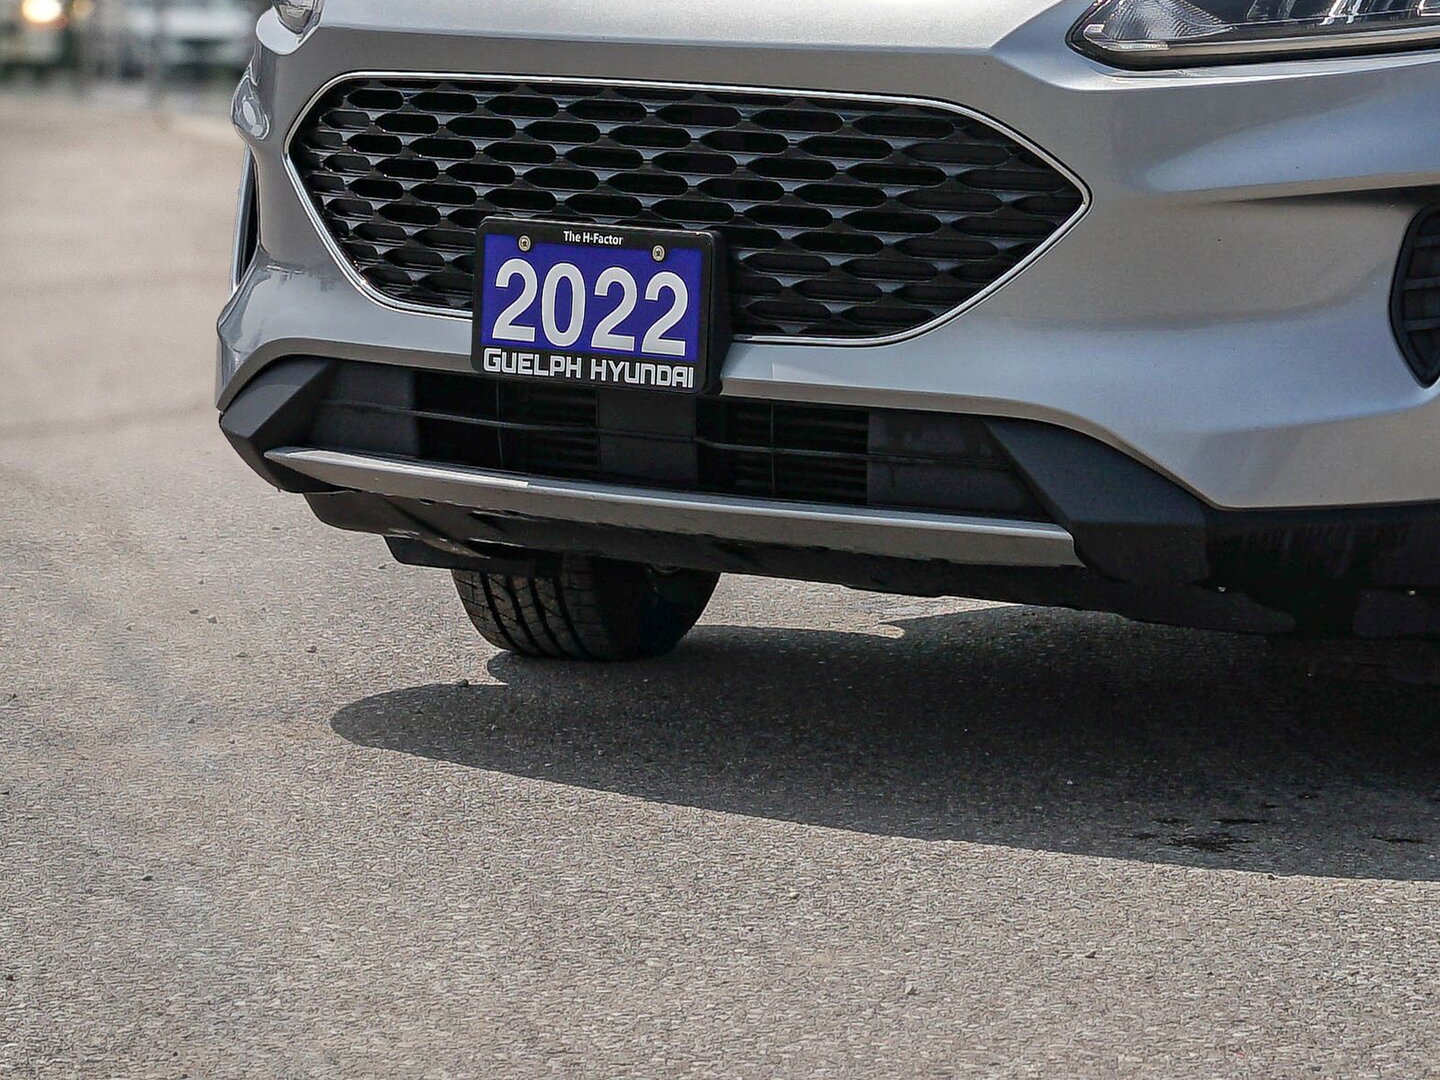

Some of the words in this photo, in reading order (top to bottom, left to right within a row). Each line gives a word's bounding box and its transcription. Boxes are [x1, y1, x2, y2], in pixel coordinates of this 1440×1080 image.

[563, 230, 581, 243] The
[583, 231, 623, 246] H-Factor
[492, 258, 689, 357] 2022
[483, 347, 582, 379] GUELPH
[590, 358, 694, 388] HYUNDAI
